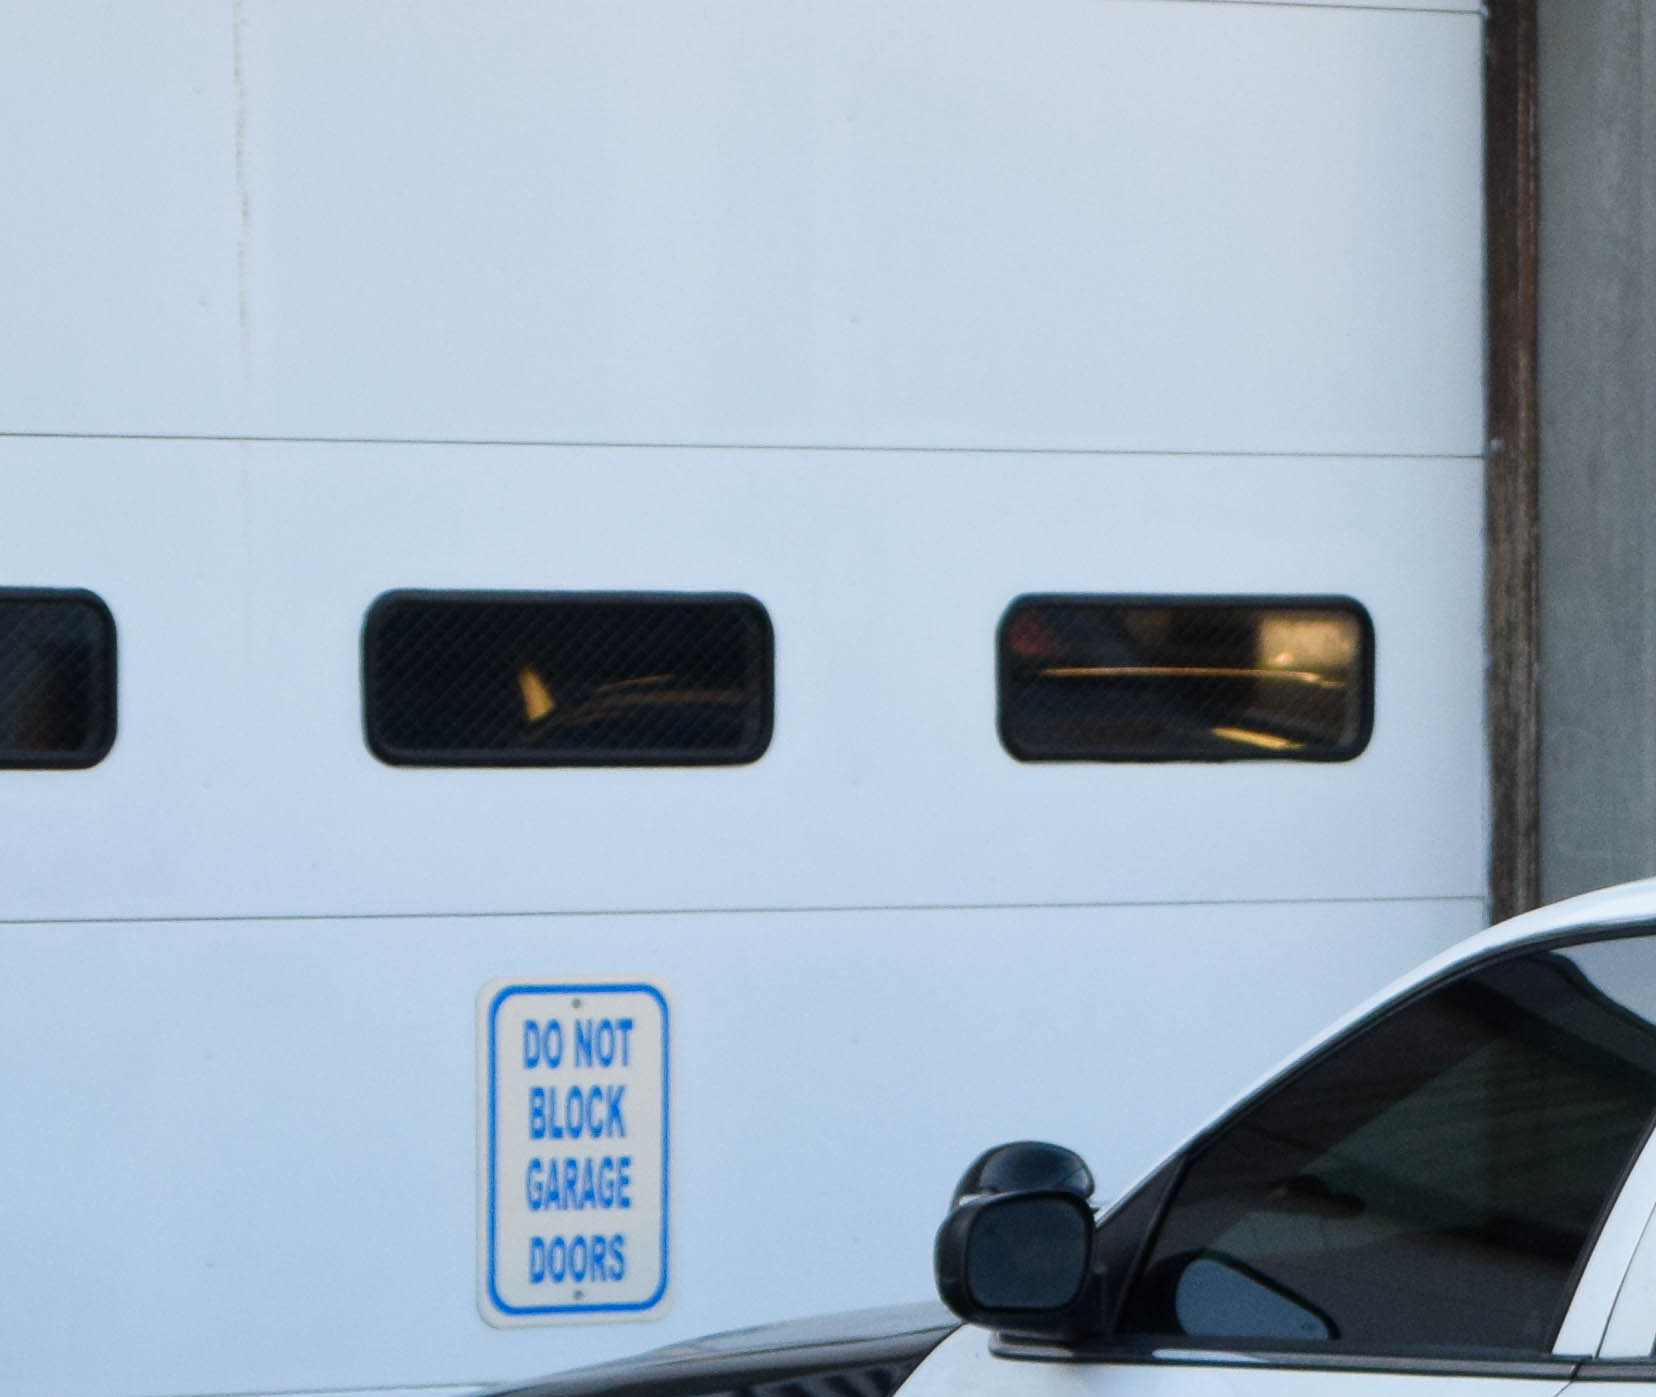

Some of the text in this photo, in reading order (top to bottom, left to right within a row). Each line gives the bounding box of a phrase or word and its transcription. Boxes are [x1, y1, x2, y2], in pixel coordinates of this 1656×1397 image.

[524, 1017, 633, 1069] DO NOT
[529, 1085, 627, 1140] BLOCK
[525, 1156, 632, 1211] GARAGE
[529, 1233, 627, 1284] DOORS
